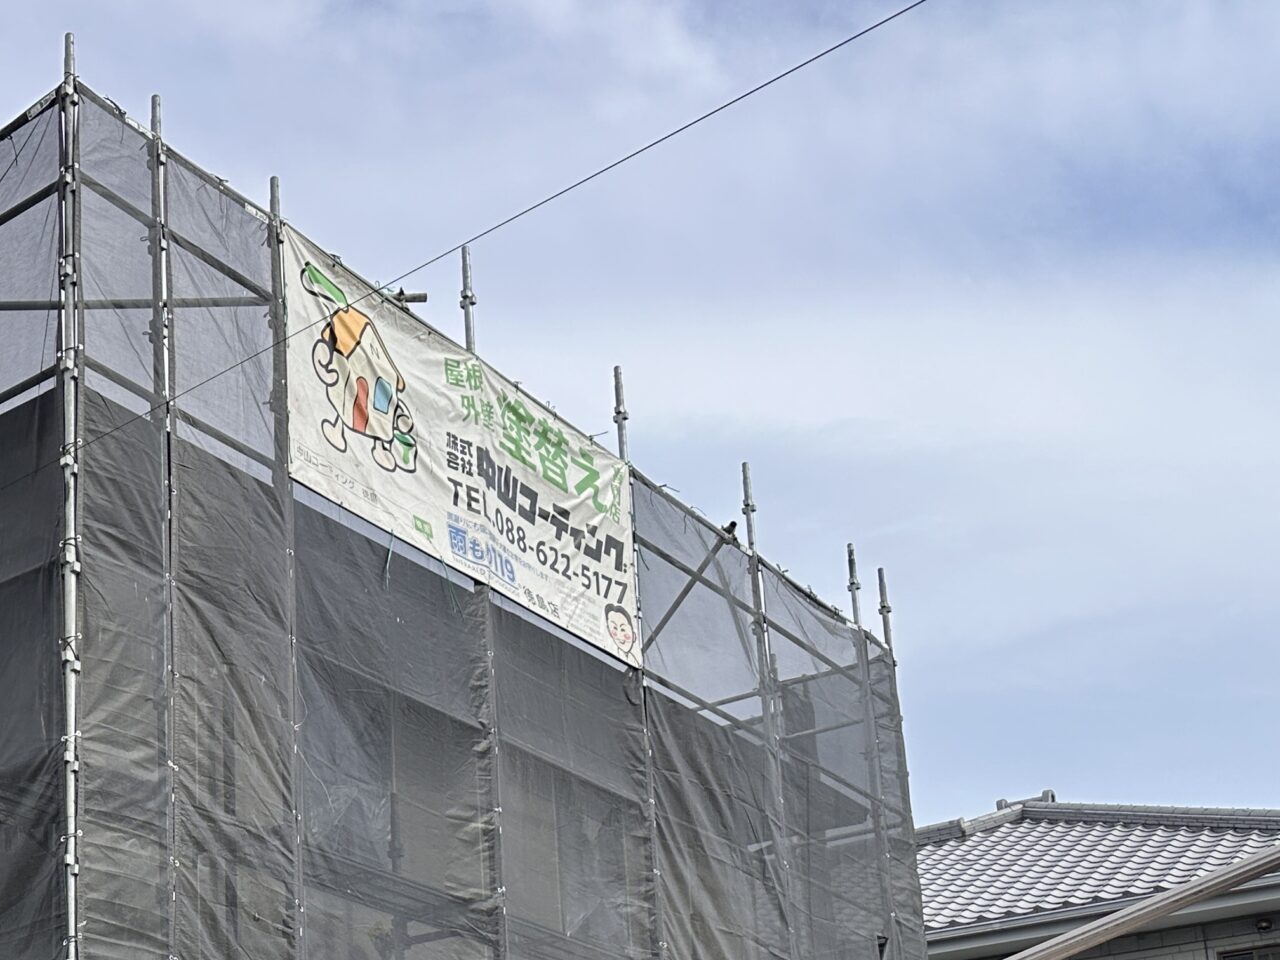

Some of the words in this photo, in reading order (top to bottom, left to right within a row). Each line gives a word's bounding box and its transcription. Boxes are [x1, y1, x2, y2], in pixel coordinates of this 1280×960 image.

[444, 356, 483, 391] 屋根
[461, 394, 495, 432] 外壁
[445, 431, 474, 457] 株式
[496, 387, 608, 514] 塗替え
[446, 451, 474, 478] 会社
[476, 444, 628, 573] 中山コーティング
